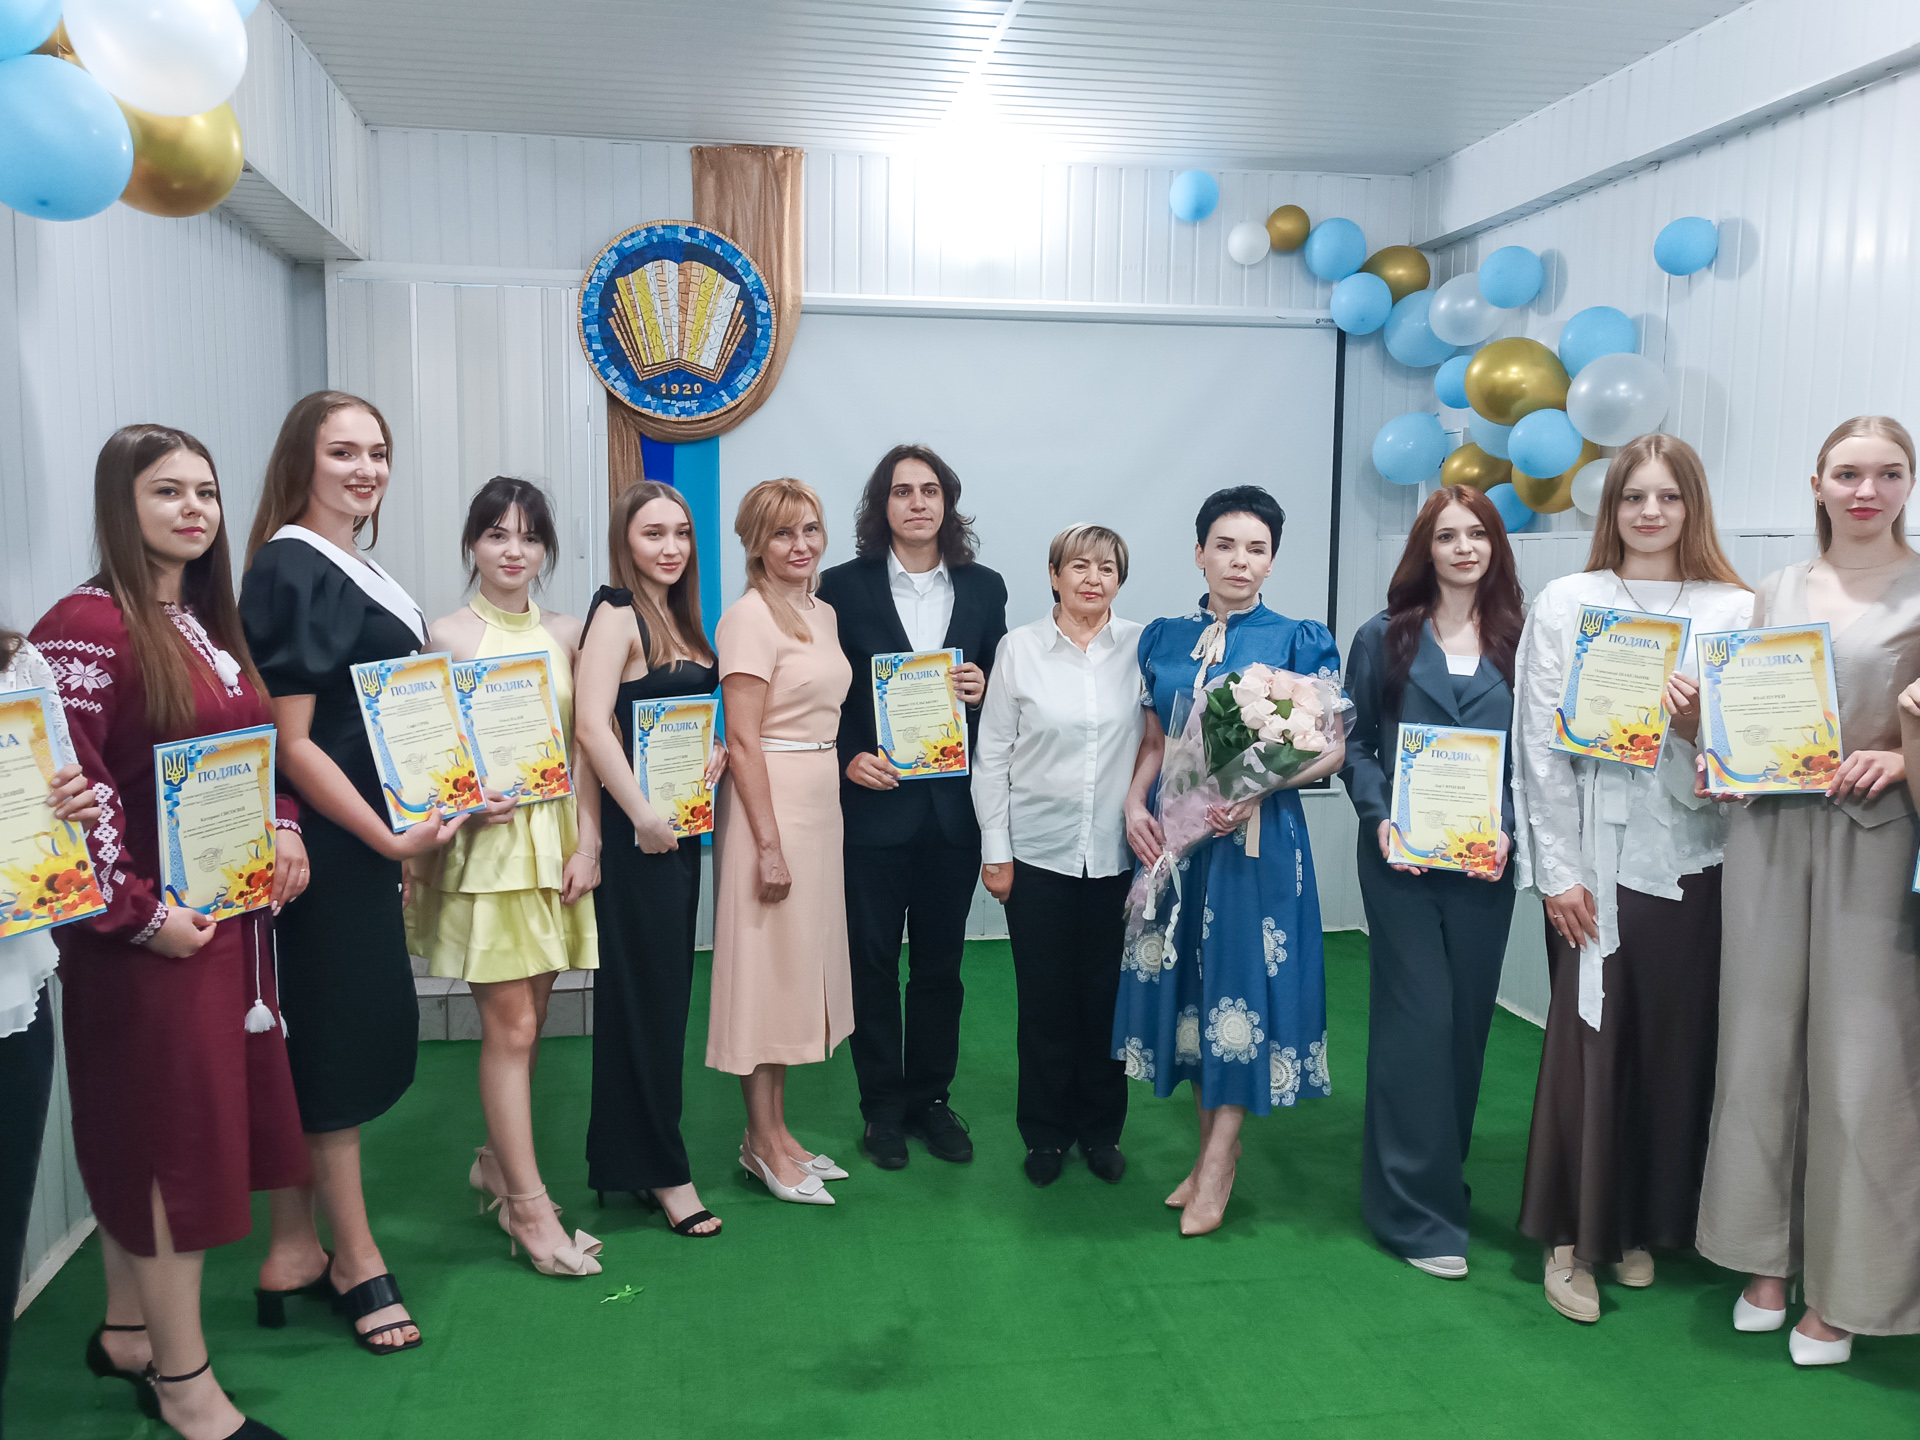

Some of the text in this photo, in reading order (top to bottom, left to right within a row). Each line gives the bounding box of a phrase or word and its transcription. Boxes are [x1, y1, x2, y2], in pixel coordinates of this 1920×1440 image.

[660, 383, 703, 394] 1920
[1608, 634, 1660, 650] ПОДЯКА
[1741, 654, 1803, 667] ПОДЯКА
[900, 670, 940, 681] ПОДЯКА
[391, 681, 437, 696] ПОДЯКА
[485, 679, 533, 693] ПОДЯКА
[660, 721, 698, 732] ПОДЯКА
[1431, 749, 1481, 762] ПОДЯКА
[198, 763, 252, 783] ПОДЯКА
